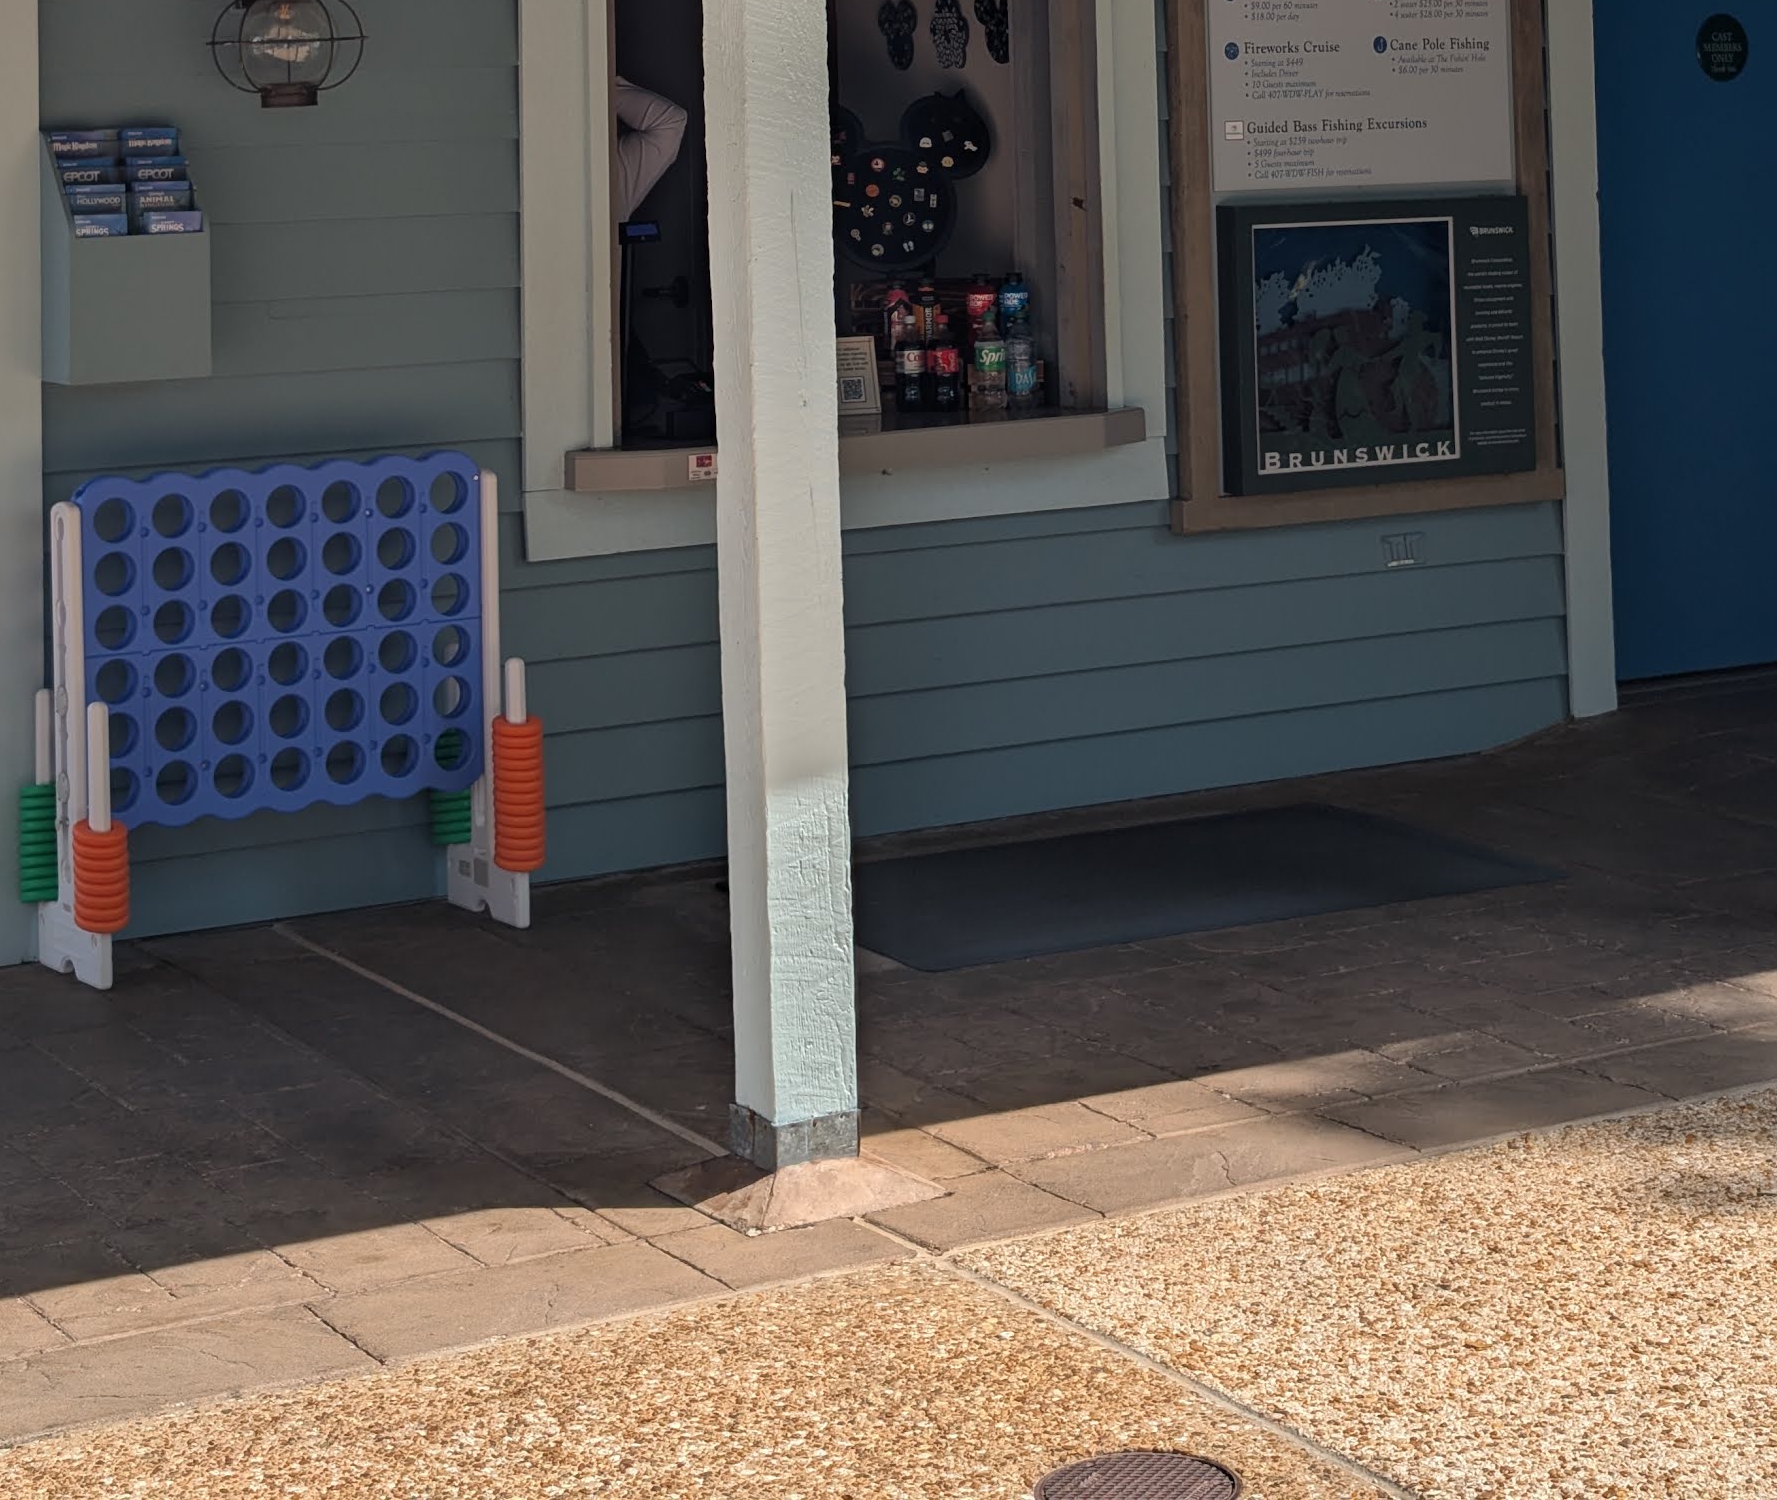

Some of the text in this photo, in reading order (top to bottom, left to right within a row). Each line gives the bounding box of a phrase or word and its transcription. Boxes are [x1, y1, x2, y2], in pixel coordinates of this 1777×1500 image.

[1711, 32, 1733, 42] CAST
[1244, 41, 1340, 54] Fireworks Cruise
[1390, 37, 1489, 51] Cane Pole Fishing
[1703, 43, 1742, 52] MEMBERS
[1711, 53, 1734, 62] ONLY
[1252, 91, 1265, 99] Call
[1247, 116, 1427, 134] Guided Bass Fishing Excursions
[63, 170, 101, 182] EPCOT
[138, 168, 174, 180] EPCOT
[1255, 170, 1268, 179] Call
[76, 196, 120, 205] HOLLYWOOD
[140, 195, 174, 203] ANIMAL
[75, 228, 110, 237] SPRINGS
[151, 223, 184, 233] SPRINGS
[1479, 226, 1514, 236] BRUNSWICK
[1003, 292, 1028, 300] POWER
[979, 349, 1005, 366] Spri
[1015, 368, 1035, 386] DAS
[1265, 440, 1452, 469] BRUNSWICK
